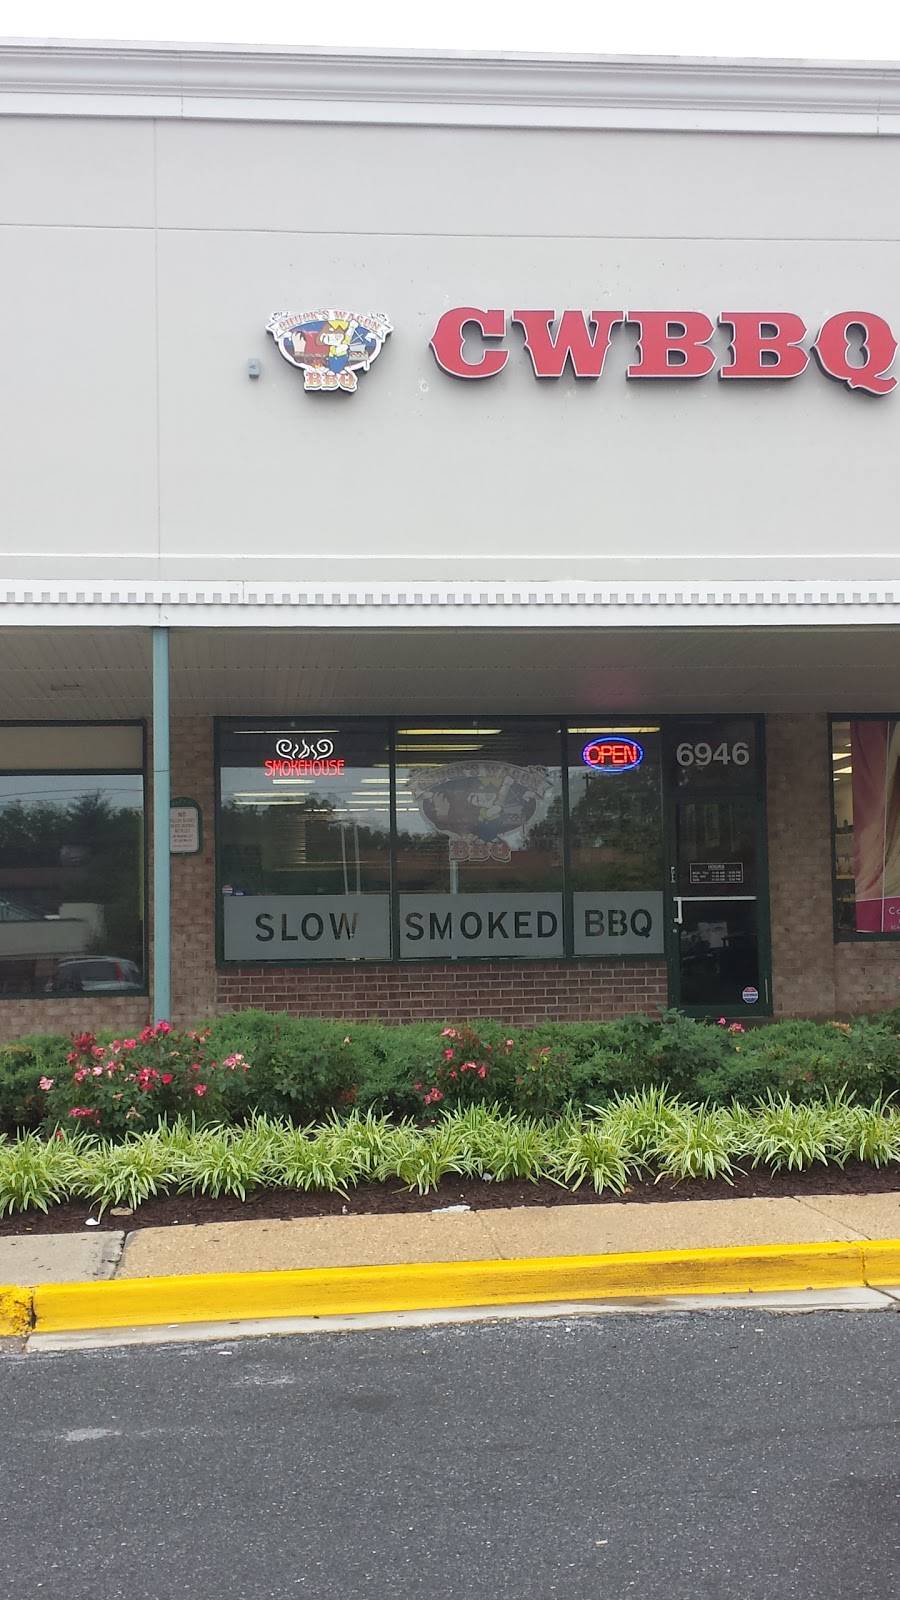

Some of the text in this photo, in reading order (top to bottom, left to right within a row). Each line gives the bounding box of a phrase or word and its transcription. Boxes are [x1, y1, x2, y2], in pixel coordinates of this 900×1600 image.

[333, 310, 382, 329] WAGON
[429, 306, 899, 396] CWBBQ
[304, 371, 358, 391] BBQ
[586, 744, 638, 764] OPEN
[676, 742, 751, 766] 6946
[264, 759, 346, 777] SMOKEHOUSE
[255, 909, 653, 942] SLOW SMOKED BBQ
